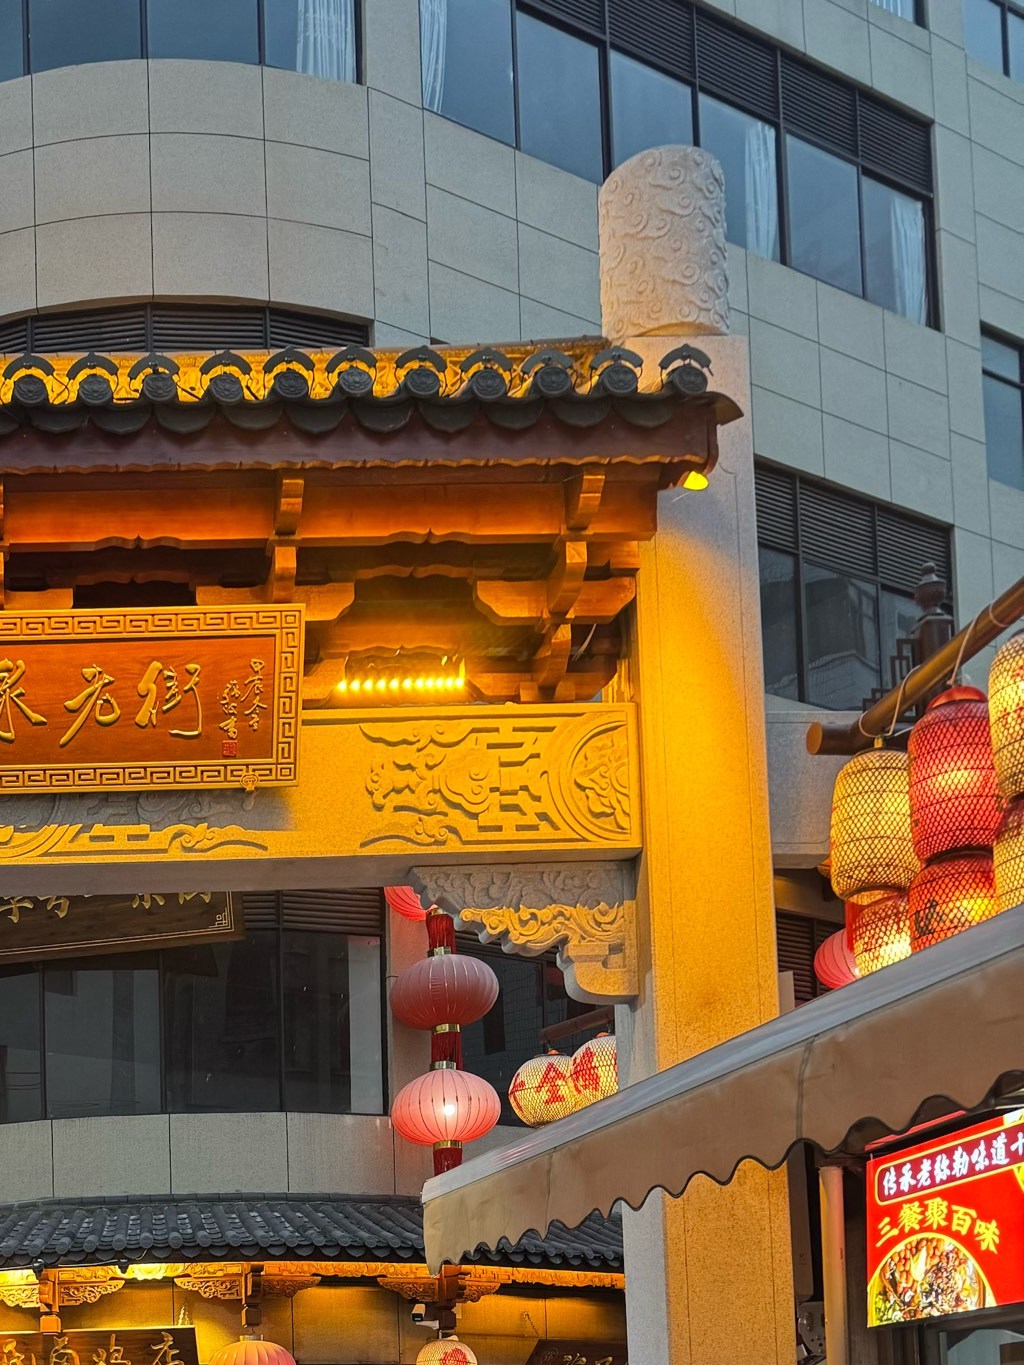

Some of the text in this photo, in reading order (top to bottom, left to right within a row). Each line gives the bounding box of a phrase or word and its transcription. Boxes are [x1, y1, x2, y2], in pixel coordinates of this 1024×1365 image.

[876, 1197, 1000, 1254] 三餐聚百味
